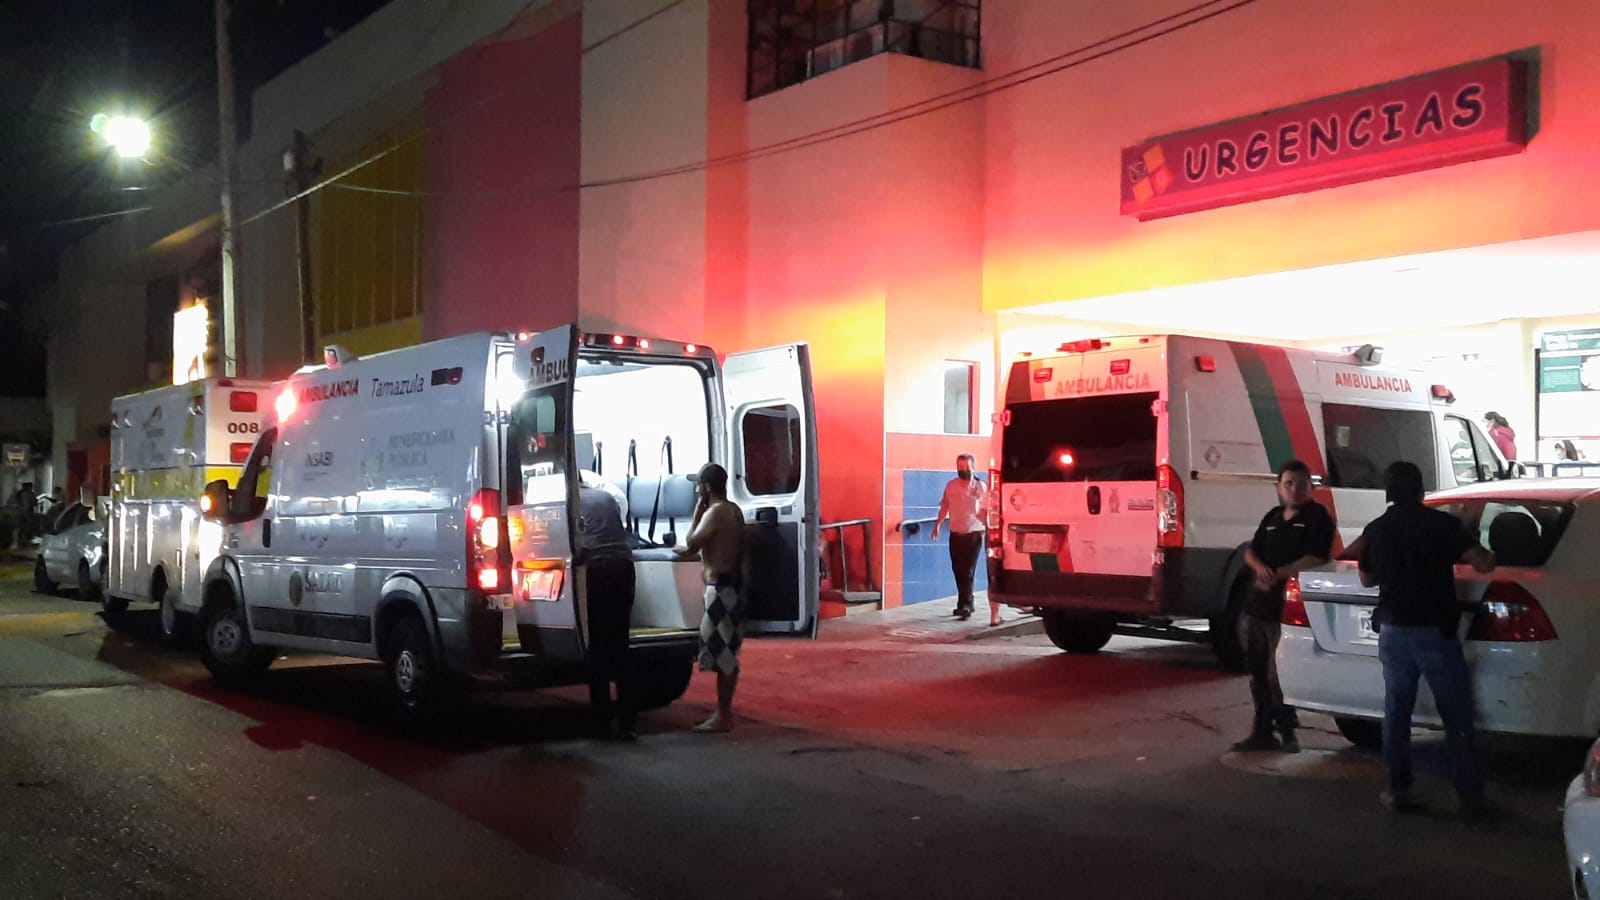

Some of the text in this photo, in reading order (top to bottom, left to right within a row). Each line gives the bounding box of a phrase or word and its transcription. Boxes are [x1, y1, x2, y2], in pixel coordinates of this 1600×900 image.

[1184, 84, 1484, 182] URGENCIAS
[371, 373, 425, 397] Tamazula
[1055, 373, 1150, 396] AMBULANCIA
[1335, 372, 1412, 393] AMBULANCIA
[228, 422, 259, 434] 008
